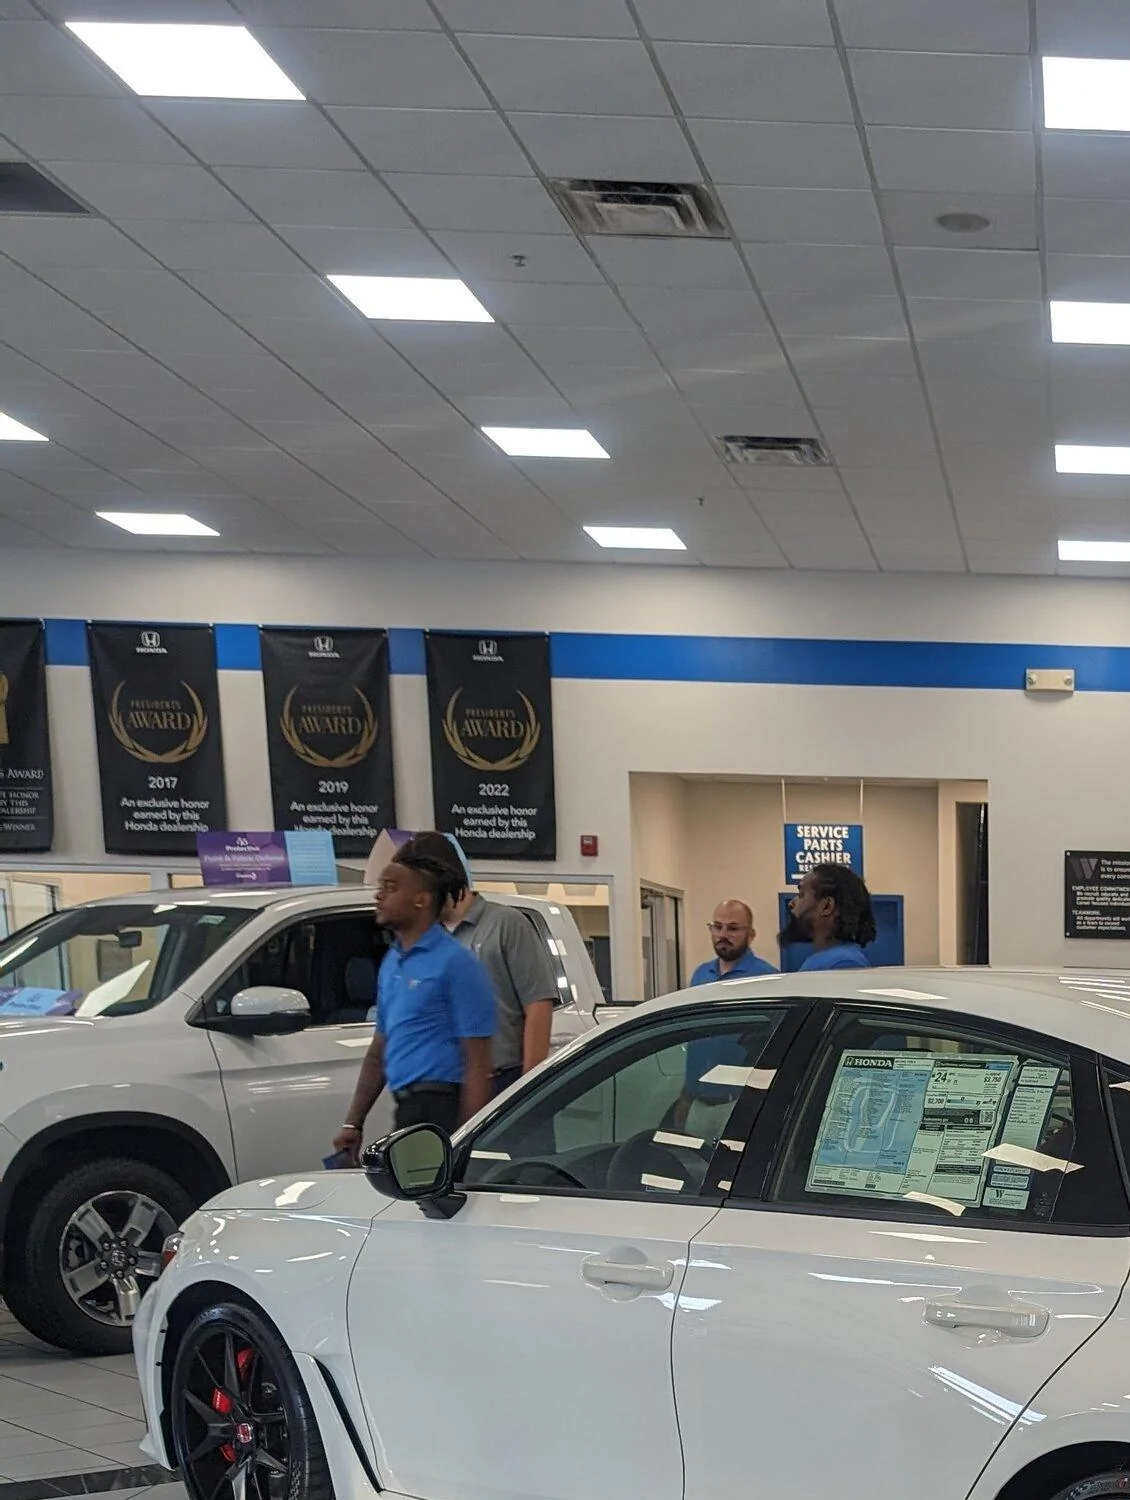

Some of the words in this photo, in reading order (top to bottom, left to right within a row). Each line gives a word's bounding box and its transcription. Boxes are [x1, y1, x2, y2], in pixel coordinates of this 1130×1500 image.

[126, 711, 191, 730] AWARD
[298, 716, 361, 734] AWARD
[461, 719, 524, 738] AWARD
[8, 768, 44, 780] AWARD
[148, 776, 178, 789] 2017
[318, 780, 349, 793] 2019
[479, 783, 510, 796] 2022
[121, 797, 136, 807] An
[137, 798, 179, 808] exclusive
[181, 799, 210, 809] honor
[290, 801, 305, 811] An
[307, 802, 349, 812] exclusive
[350, 802, 378, 813] honor
[133, 810, 167, 820] earned
[168, 810, 181, 822] by
[182, 811, 200, 820] this
[451, 804, 465, 814] An
[467, 805, 509, 815] exclusive
[510, 805, 537, 816] honor
[125, 821, 158, 831] Honda
[159, 822, 209, 833] dealership
[302, 814, 336, 824] earned
[338, 814, 351, 828] by
[352, 815, 369, 825] this
[463, 816, 496, 826] earned
[498, 817, 509, 828] by
[511, 817, 527, 827] this
[455, 828, 487, 838] Honda
[489, 828, 536, 840] dealership
[796, 825, 849, 839] SERVICE
[803, 839, 844, 851] PARTS
[795, 851, 852, 864] CASHIER
[854, 1058, 893, 1067] HONDA
[934, 1071, 948, 1083] 24
